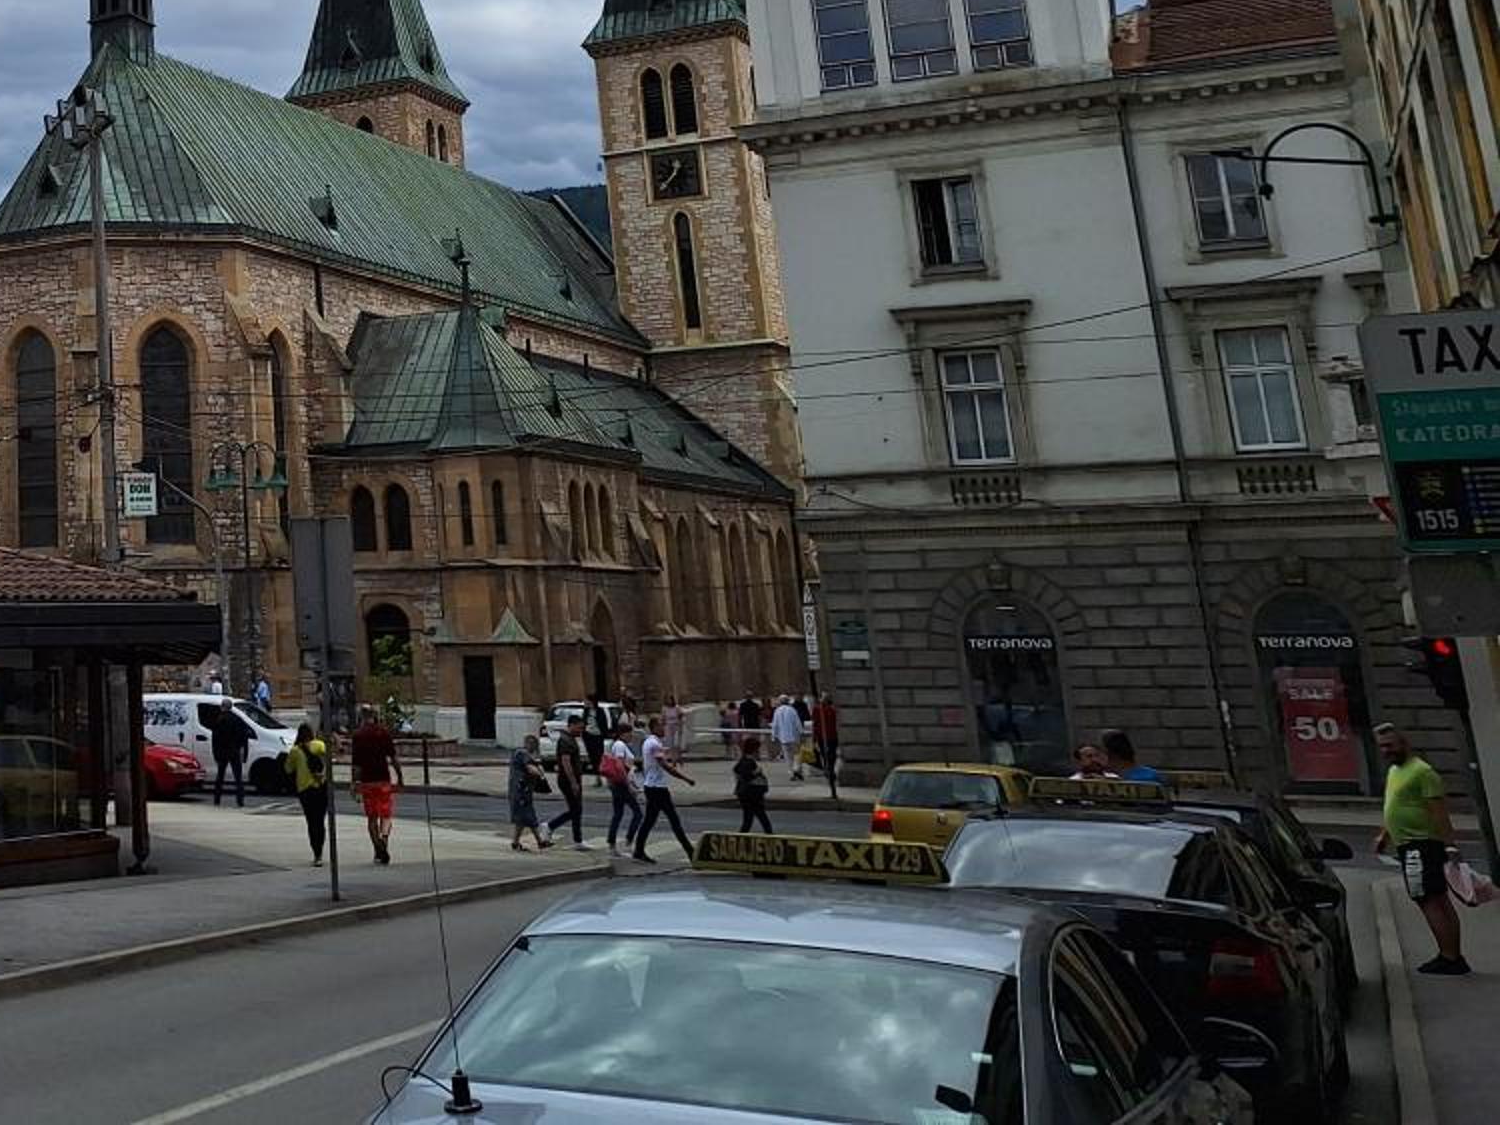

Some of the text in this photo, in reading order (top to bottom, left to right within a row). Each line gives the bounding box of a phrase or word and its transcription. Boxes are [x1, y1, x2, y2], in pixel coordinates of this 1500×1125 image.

[1415, 508, 1460, 532] 1515
[1288, 687, 1333, 700] SALE
[708, 835, 924, 874] SARAJEVO TAXI 229
